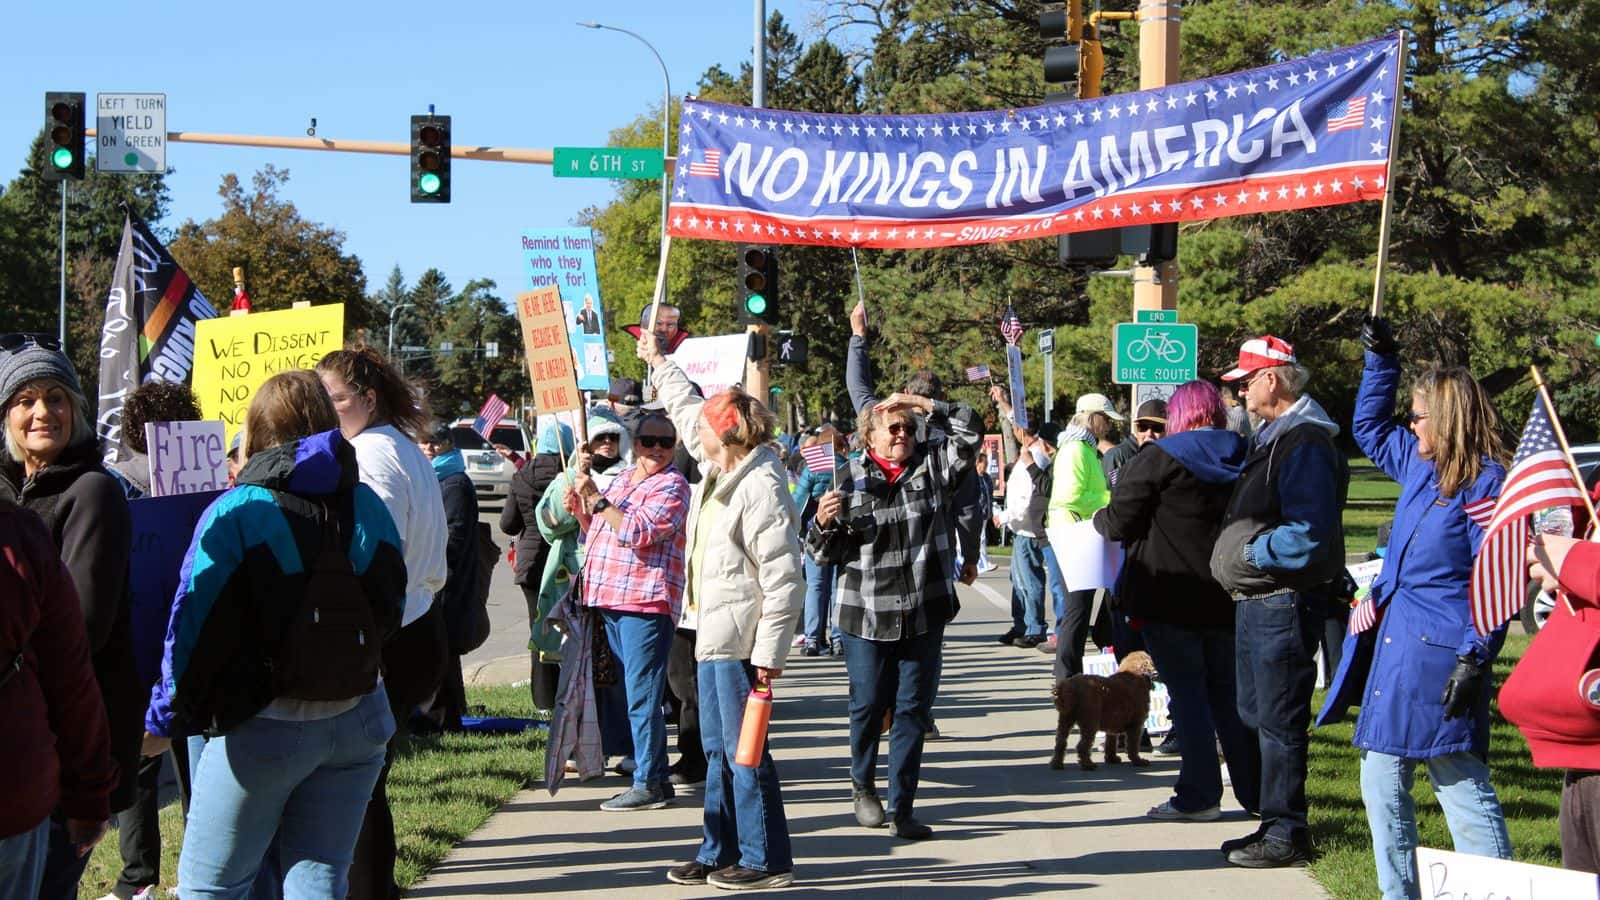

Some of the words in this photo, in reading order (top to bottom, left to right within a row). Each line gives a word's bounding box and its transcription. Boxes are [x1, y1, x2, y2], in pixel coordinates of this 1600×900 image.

[99, 98, 125, 110] LEFT
[136, 98, 164, 110] TURN
[112, 115, 153, 130] YIELD
[102, 135, 117, 147] ON
[125, 135, 161, 147] GREEN
[723, 141, 809, 202] NO
[810, 148, 978, 210] KINGS
[986, 144, 1048, 209] IN
[1062, 97, 1317, 201] AMERICA
[571, 159, 579, 171] N
[589, 154, 622, 172] 6TH
[631, 160, 646, 172] ST
[522, 235, 560, 250] Remind
[562, 235, 592, 250] them
[531, 254, 552, 269] who
[557, 255, 582, 271] they
[531, 272, 558, 287] work
[565, 271, 587, 287] for!
[1149, 312, 1165, 321] END
[210, 336, 245, 359] WE
[253, 330, 330, 355] DISSENT
[221, 361, 251, 381] NO
[264, 352, 320, 375] KINGS
[1121, 367, 1146, 380] BIKE
[1154, 368, 1191, 381] ROUTE
[220, 384, 249, 404] NO
[153, 421, 223, 473] Fire
